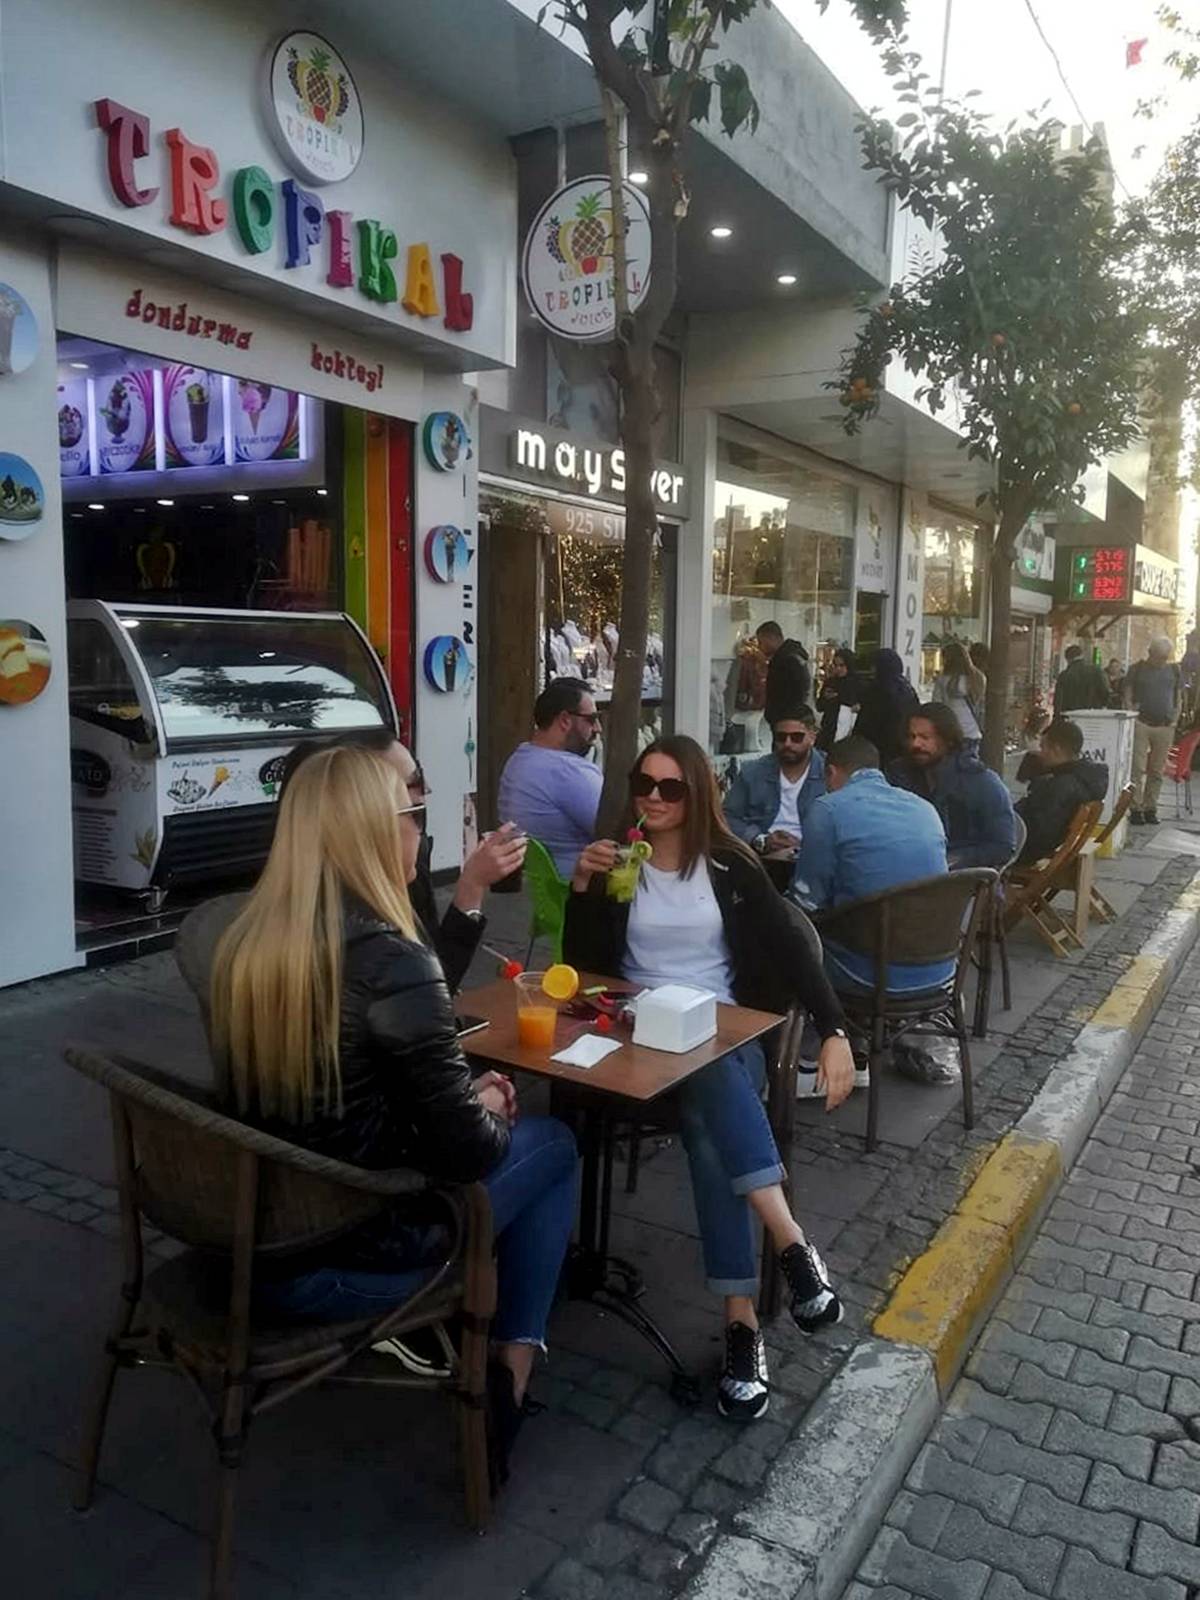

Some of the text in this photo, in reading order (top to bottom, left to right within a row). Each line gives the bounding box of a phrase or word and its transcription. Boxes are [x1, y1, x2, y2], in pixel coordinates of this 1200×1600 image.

[93, 97, 473, 332] TROPIKAL
[126, 289, 253, 350] dondurma
[565, 509, 595, 535] 925
